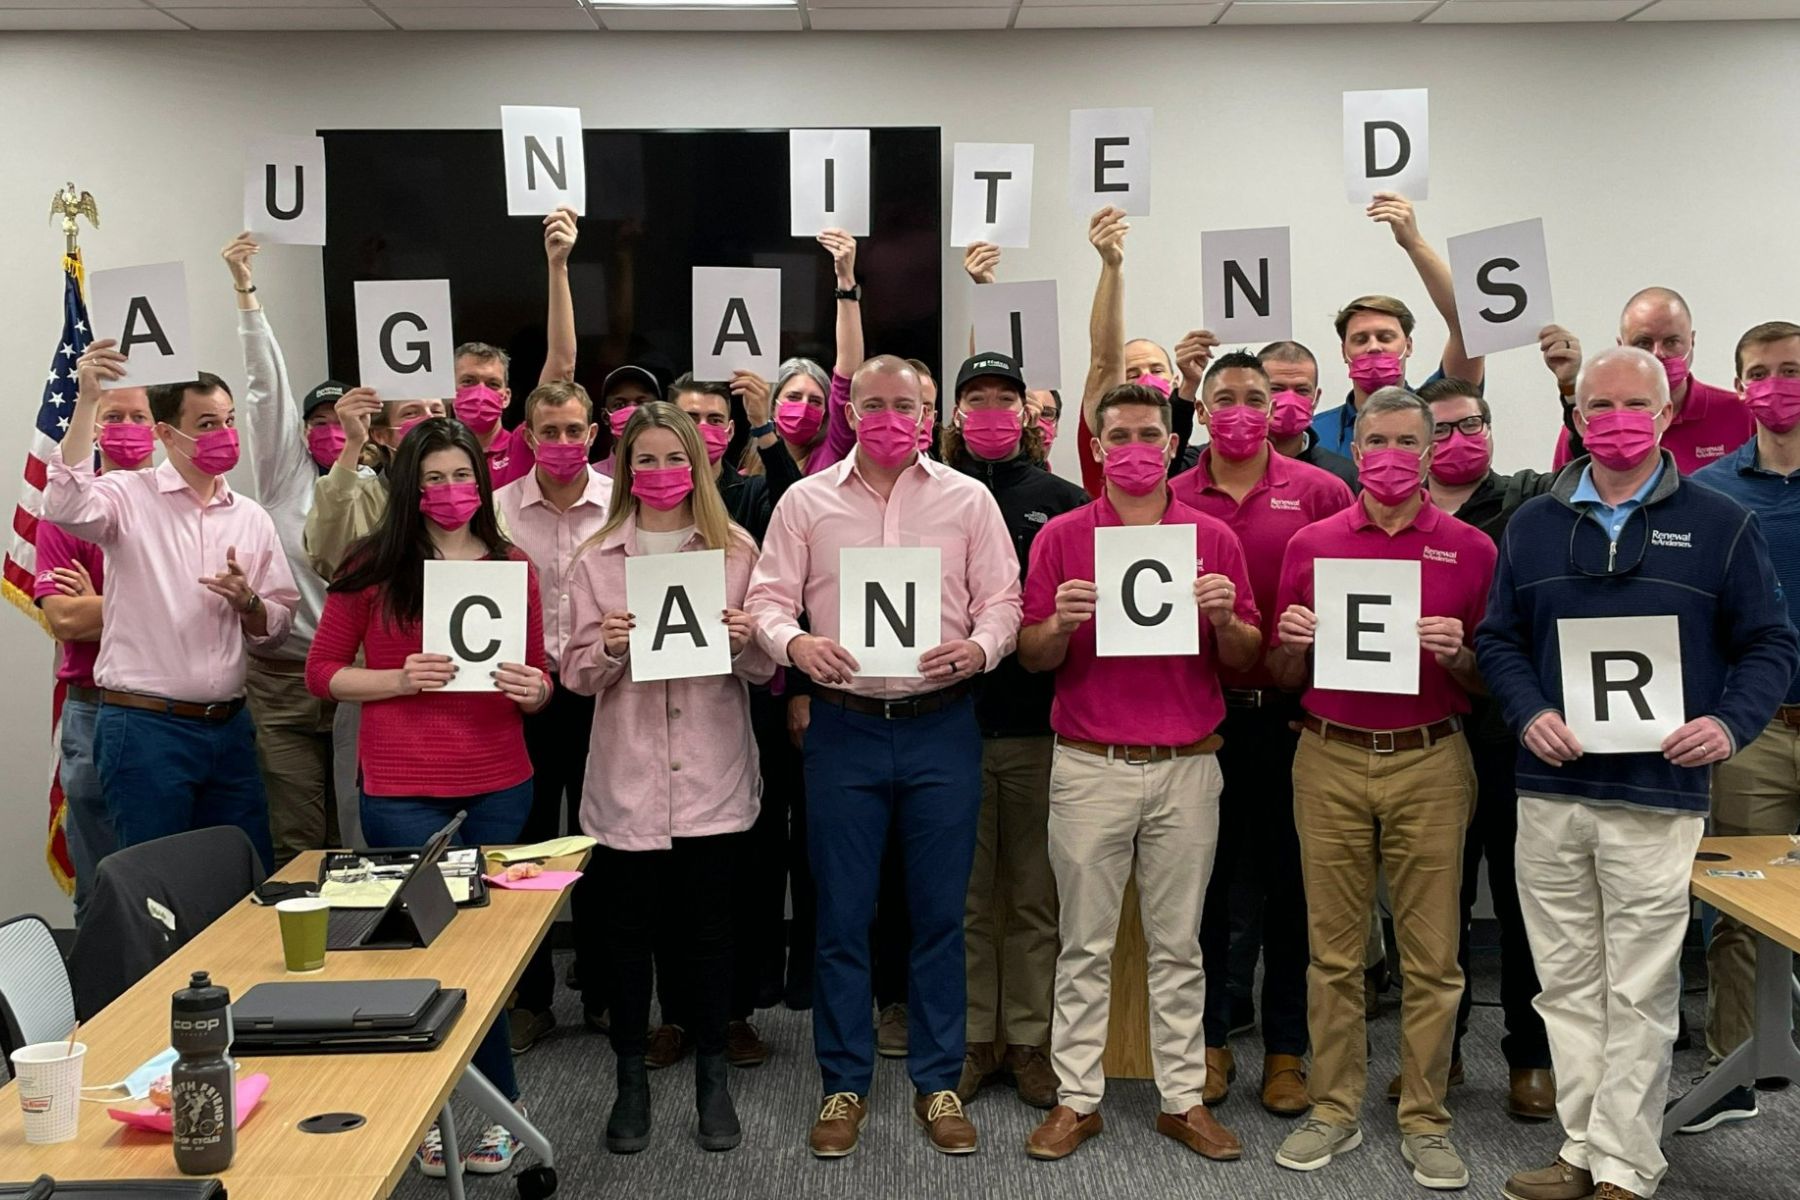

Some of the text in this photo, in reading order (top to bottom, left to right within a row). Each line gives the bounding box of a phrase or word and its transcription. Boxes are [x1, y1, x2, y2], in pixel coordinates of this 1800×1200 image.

[524, 135, 568, 191] N
[1094, 136, 1130, 193] E
[1364, 120, 1411, 179] D
[265, 163, 304, 221] U
[824, 158, 836, 213] I
[974, 171, 1012, 224] T
[1223, 257, 1270, 319] N
[1476, 257, 1528, 324] S
[119, 296, 175, 359] A
[379, 311, 432, 374] G
[711, 297, 762, 357] A
[1010, 311, 1024, 368] I
[1423, 545, 1457, 558] Renewal
[1651, 529, 1692, 541] Renewal
[651, 584, 709, 652] A
[865, 581, 916, 648] N
[1121, 559, 1174, 627] C
[449, 594, 502, 663] C
[1346, 593, 1393, 663] E
[1590, 650, 1656, 722] R
[199, 1082, 225, 1130] FRIENDS
